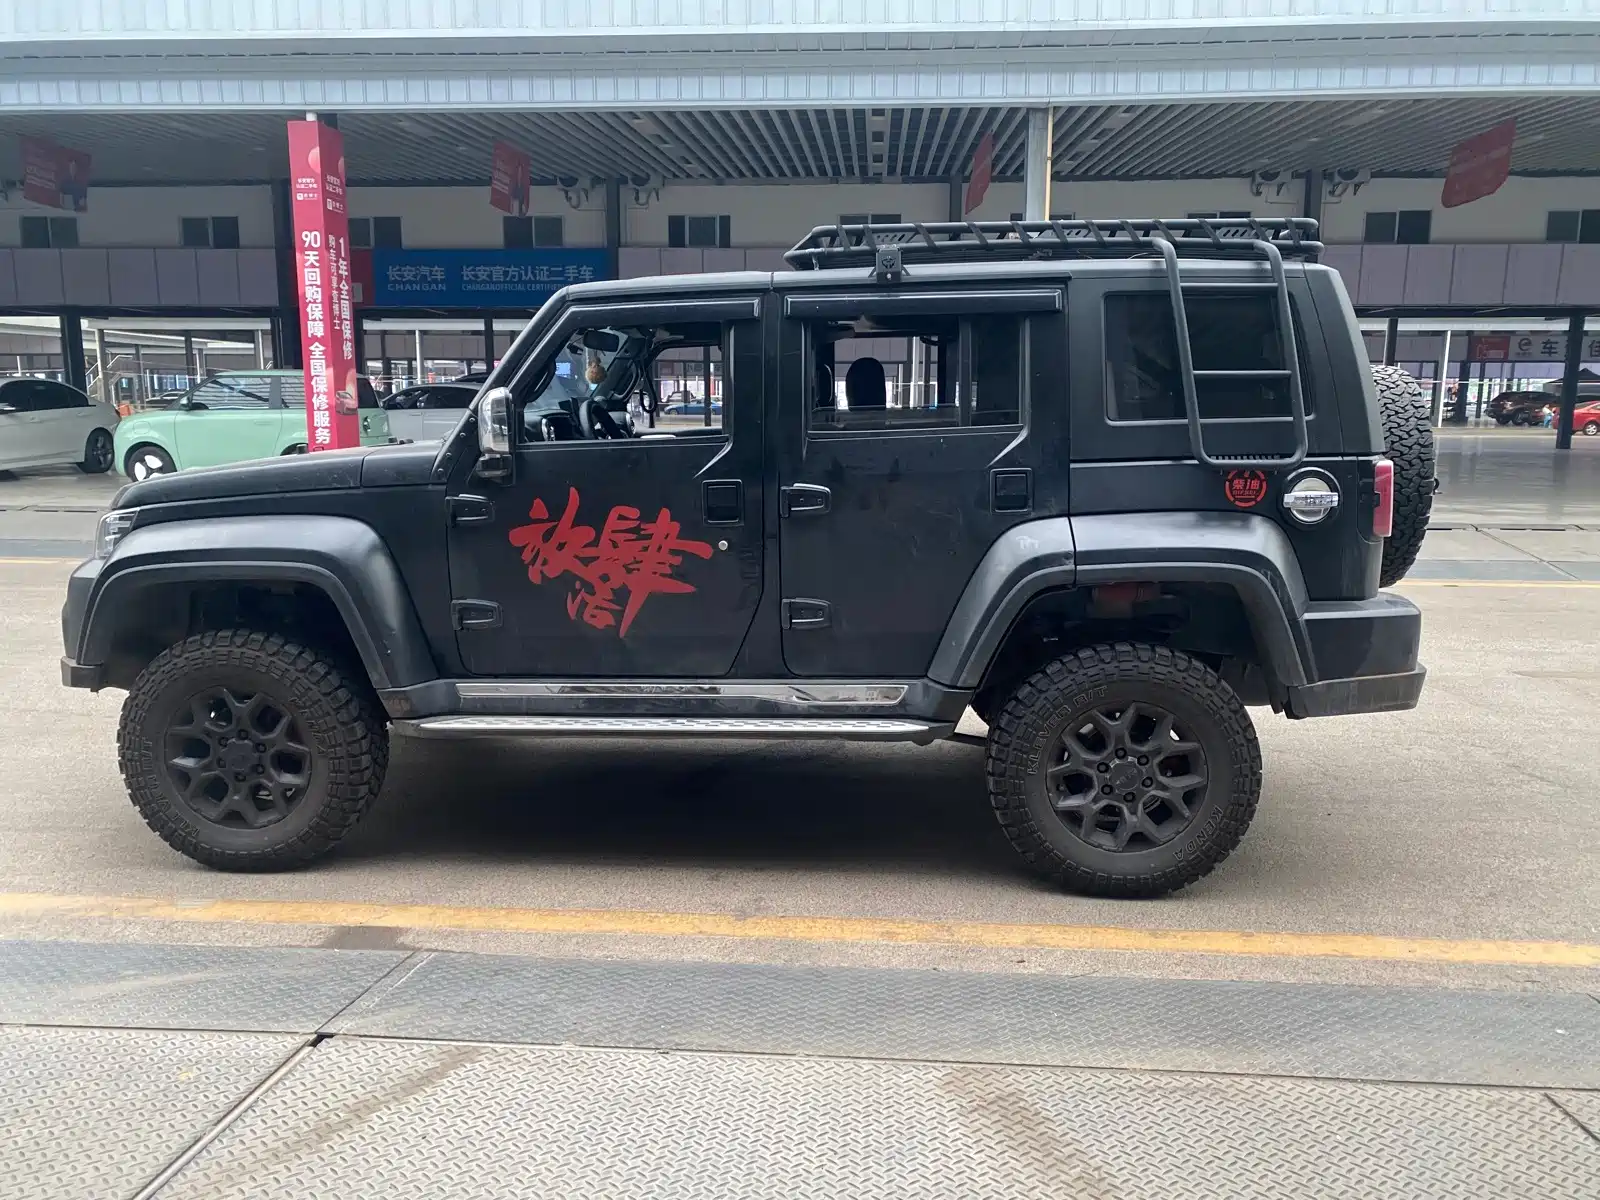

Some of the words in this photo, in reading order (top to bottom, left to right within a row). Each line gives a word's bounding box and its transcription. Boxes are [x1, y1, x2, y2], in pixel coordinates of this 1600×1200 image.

[302, 231, 324, 338] 90天回购保障
[338, 236, 353, 361] 1年全国保修
[387, 265, 445, 281] 长安汽车
[461, 265, 595, 281] 长安官方认证二手车
[308, 342, 332, 444] 全国保修服务
[1232, 479, 1260, 489] 柴油
[1173, 806, 1224, 861] KENDA
